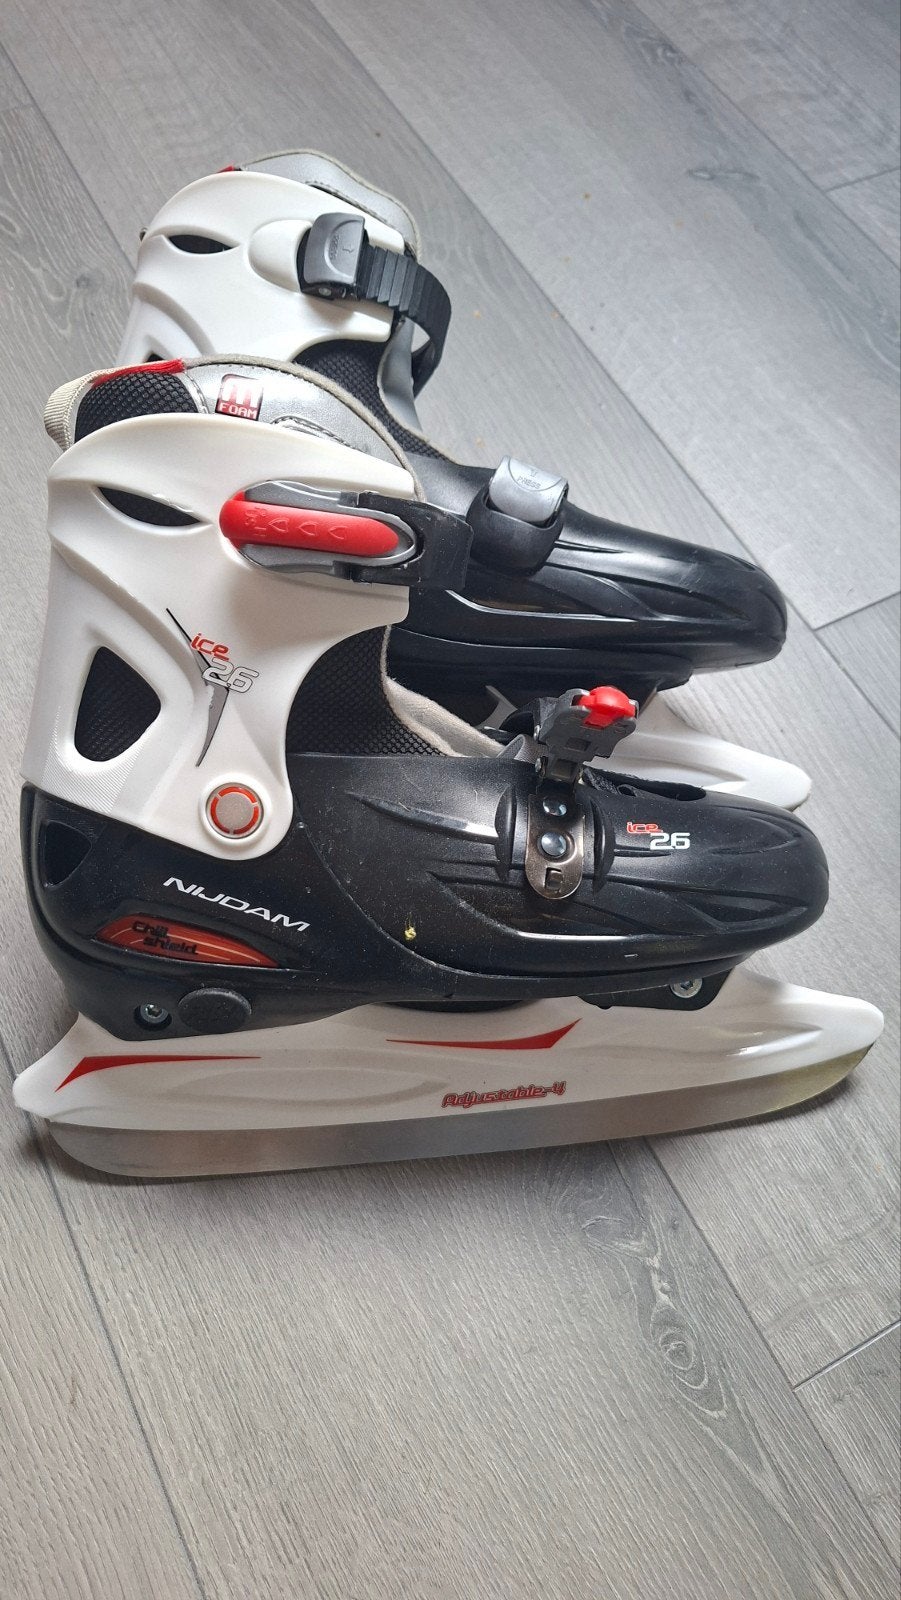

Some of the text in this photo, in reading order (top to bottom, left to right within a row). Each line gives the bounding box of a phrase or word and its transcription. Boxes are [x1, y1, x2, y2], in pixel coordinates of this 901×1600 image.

[219, 402, 258, 420] FOAM
[191, 632, 230, 662] ice
[626, 821, 664, 834] ice
[163, 876, 311, 932] NIJDAM
